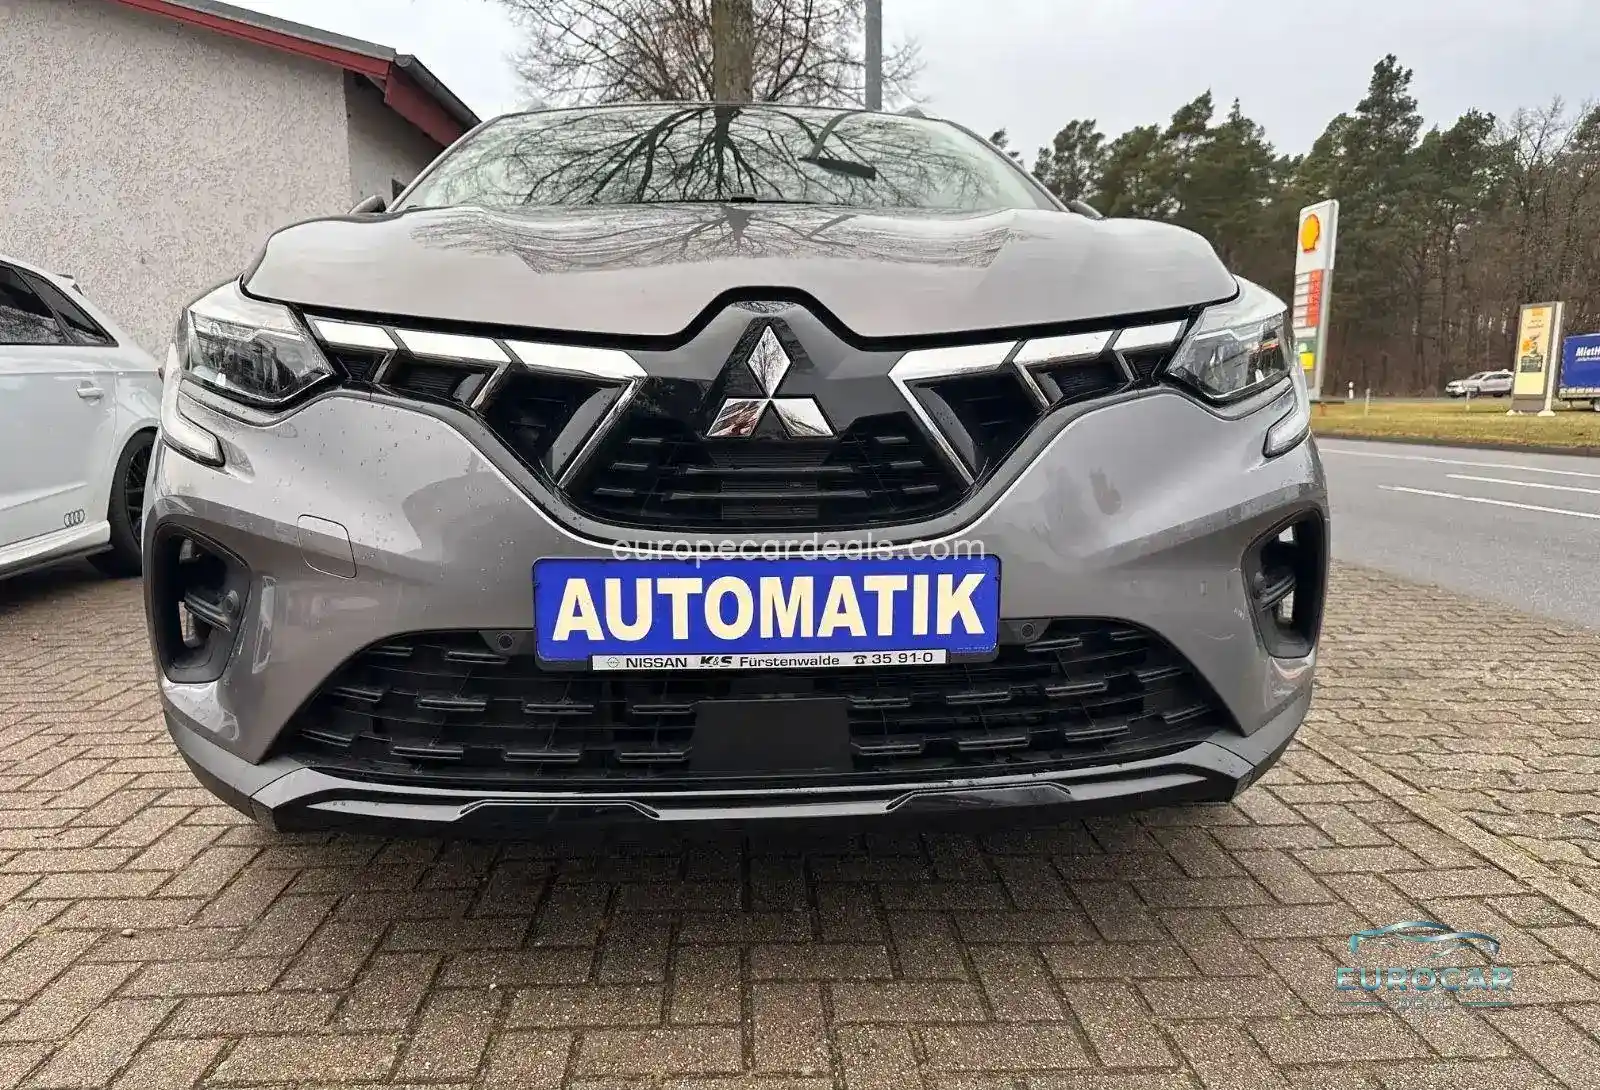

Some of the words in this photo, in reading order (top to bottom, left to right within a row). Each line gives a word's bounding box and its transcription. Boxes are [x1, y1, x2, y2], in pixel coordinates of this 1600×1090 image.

[552, 573, 986, 641] AUTOMATIK
[626, 657, 687, 668] NISSAN
[700, 655, 733, 667] K&S
[739, 655, 840, 668] Fürstenwalde
[871, 653, 892, 664] 35
